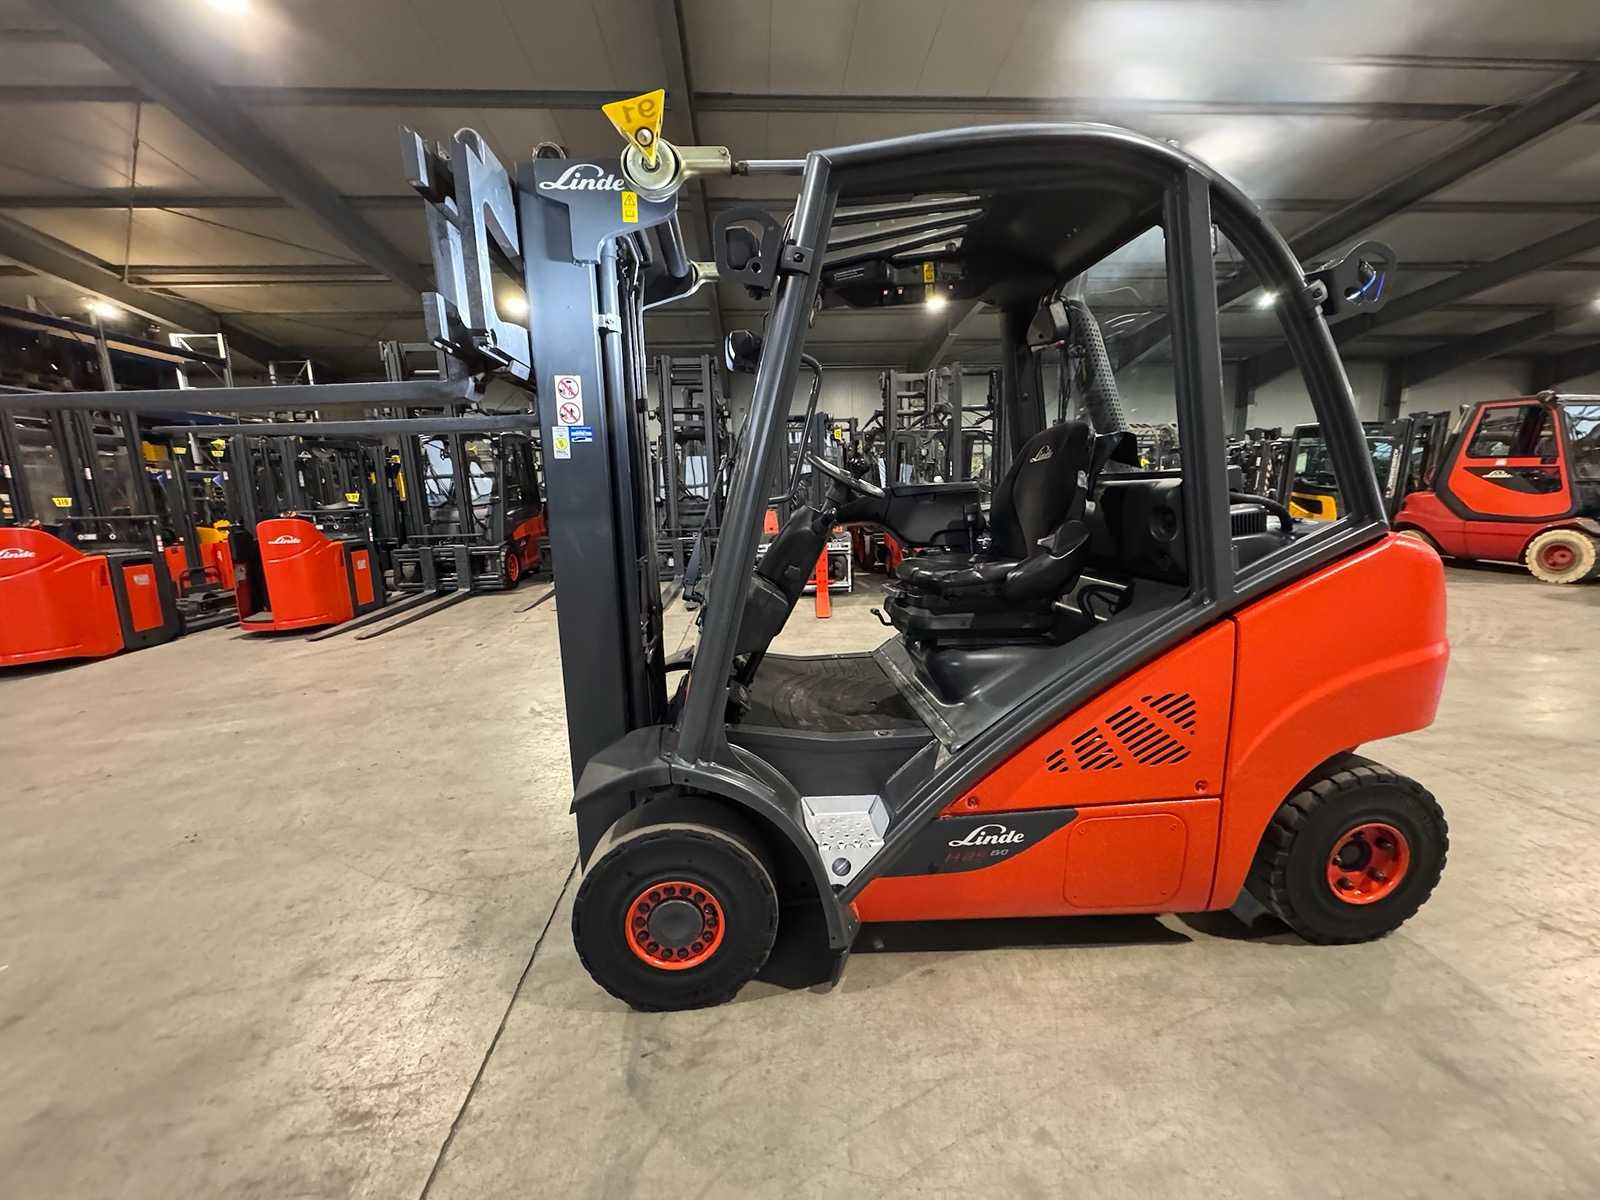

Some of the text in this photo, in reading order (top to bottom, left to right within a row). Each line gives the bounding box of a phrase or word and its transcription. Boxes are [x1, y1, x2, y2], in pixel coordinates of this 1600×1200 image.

[539, 163, 625, 191] Linde
[268, 535, 301, 545] Linde
[948, 824, 1024, 847] Linde
